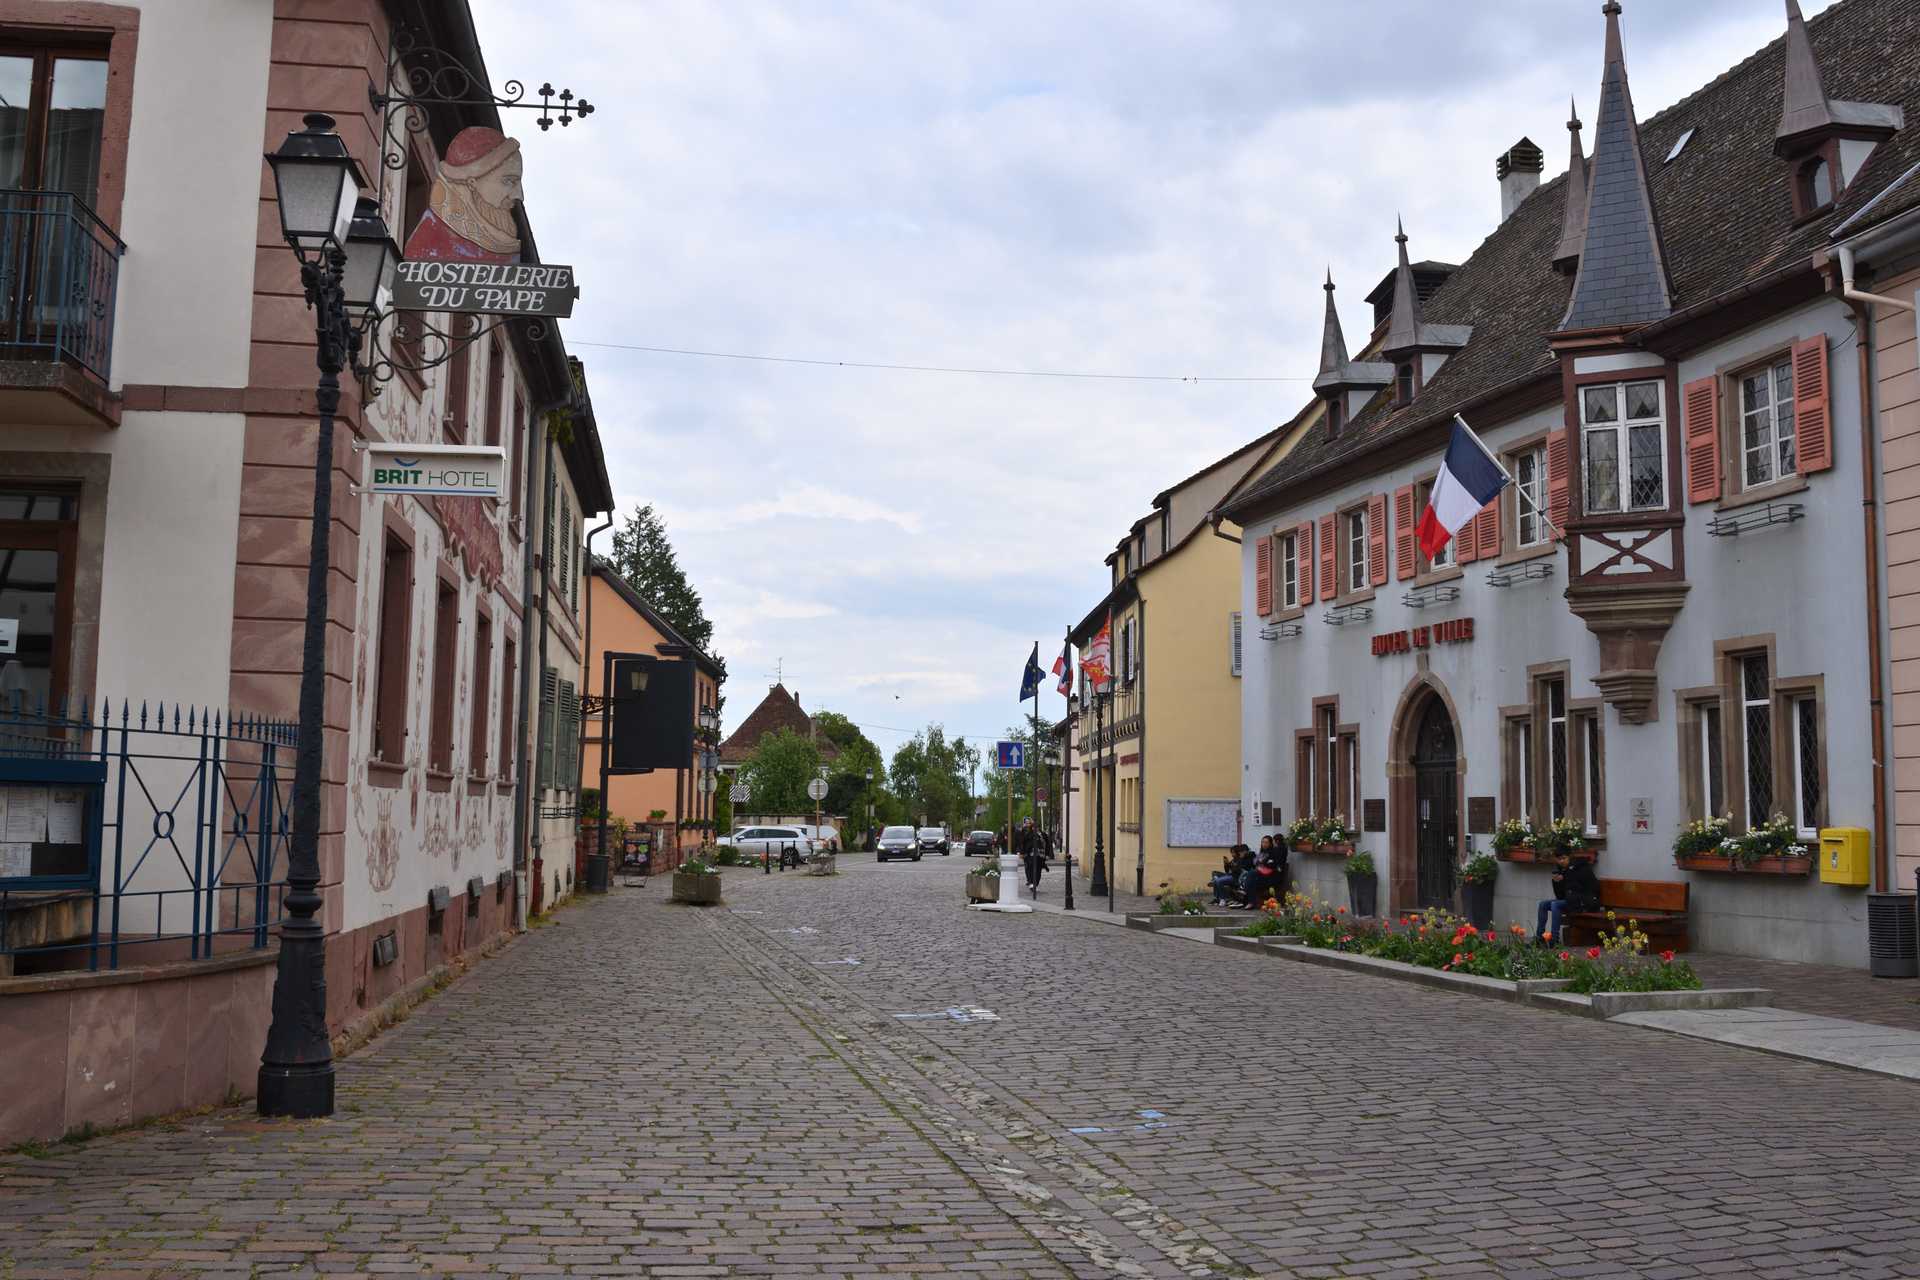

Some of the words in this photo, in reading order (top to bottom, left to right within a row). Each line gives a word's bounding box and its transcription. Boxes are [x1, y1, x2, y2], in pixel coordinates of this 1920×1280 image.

[397, 261, 570, 289] HOSTELLERIE
[419, 286, 469, 308] DU
[475, 288, 547, 312] PAPE
[374, 468, 422, 485] BRIT
[428, 470, 497, 487] HOTEL
